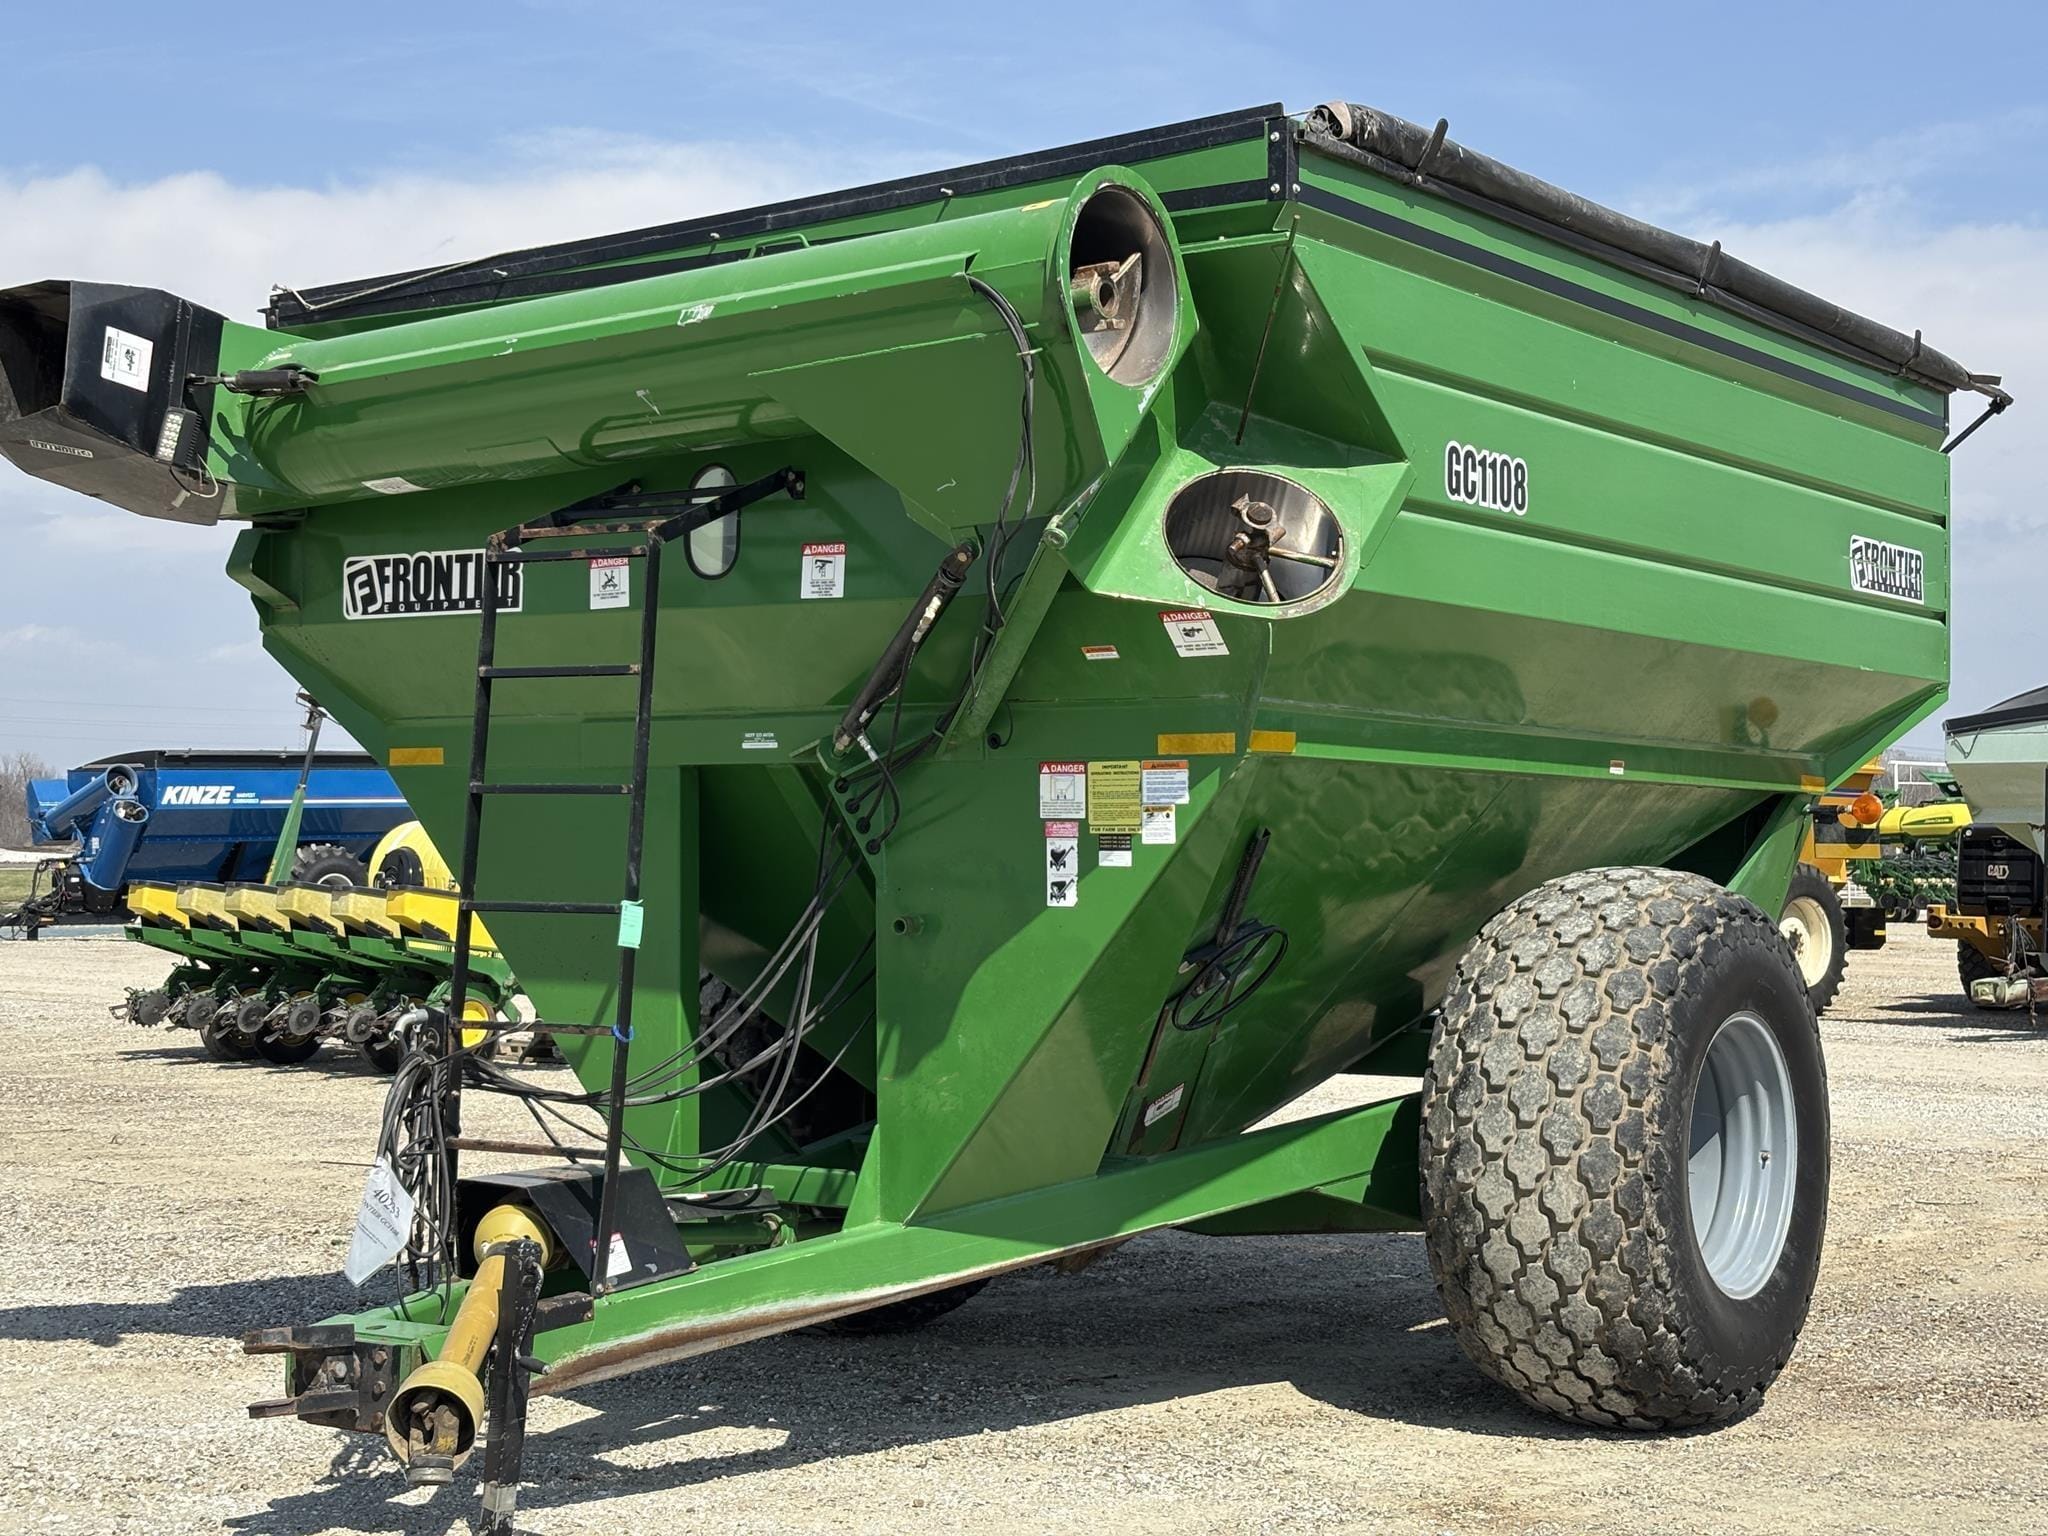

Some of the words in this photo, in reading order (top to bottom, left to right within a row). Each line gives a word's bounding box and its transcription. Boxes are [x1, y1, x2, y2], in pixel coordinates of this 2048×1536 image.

[1446, 445, 1527, 512] GC1108
[811, 544, 846, 554] DANGER
[597, 557, 629, 567] DANGER
[1864, 541, 1922, 592] FRONTIER
[377, 551, 521, 602] FRONTIR
[383, 597, 512, 613] EQUIPMET
[1169, 611, 1212, 621] DANGER
[1050, 764, 1085, 773] DANGER
[161, 785, 236, 805] KINZE
[1987, 864, 2008, 878] CAT
